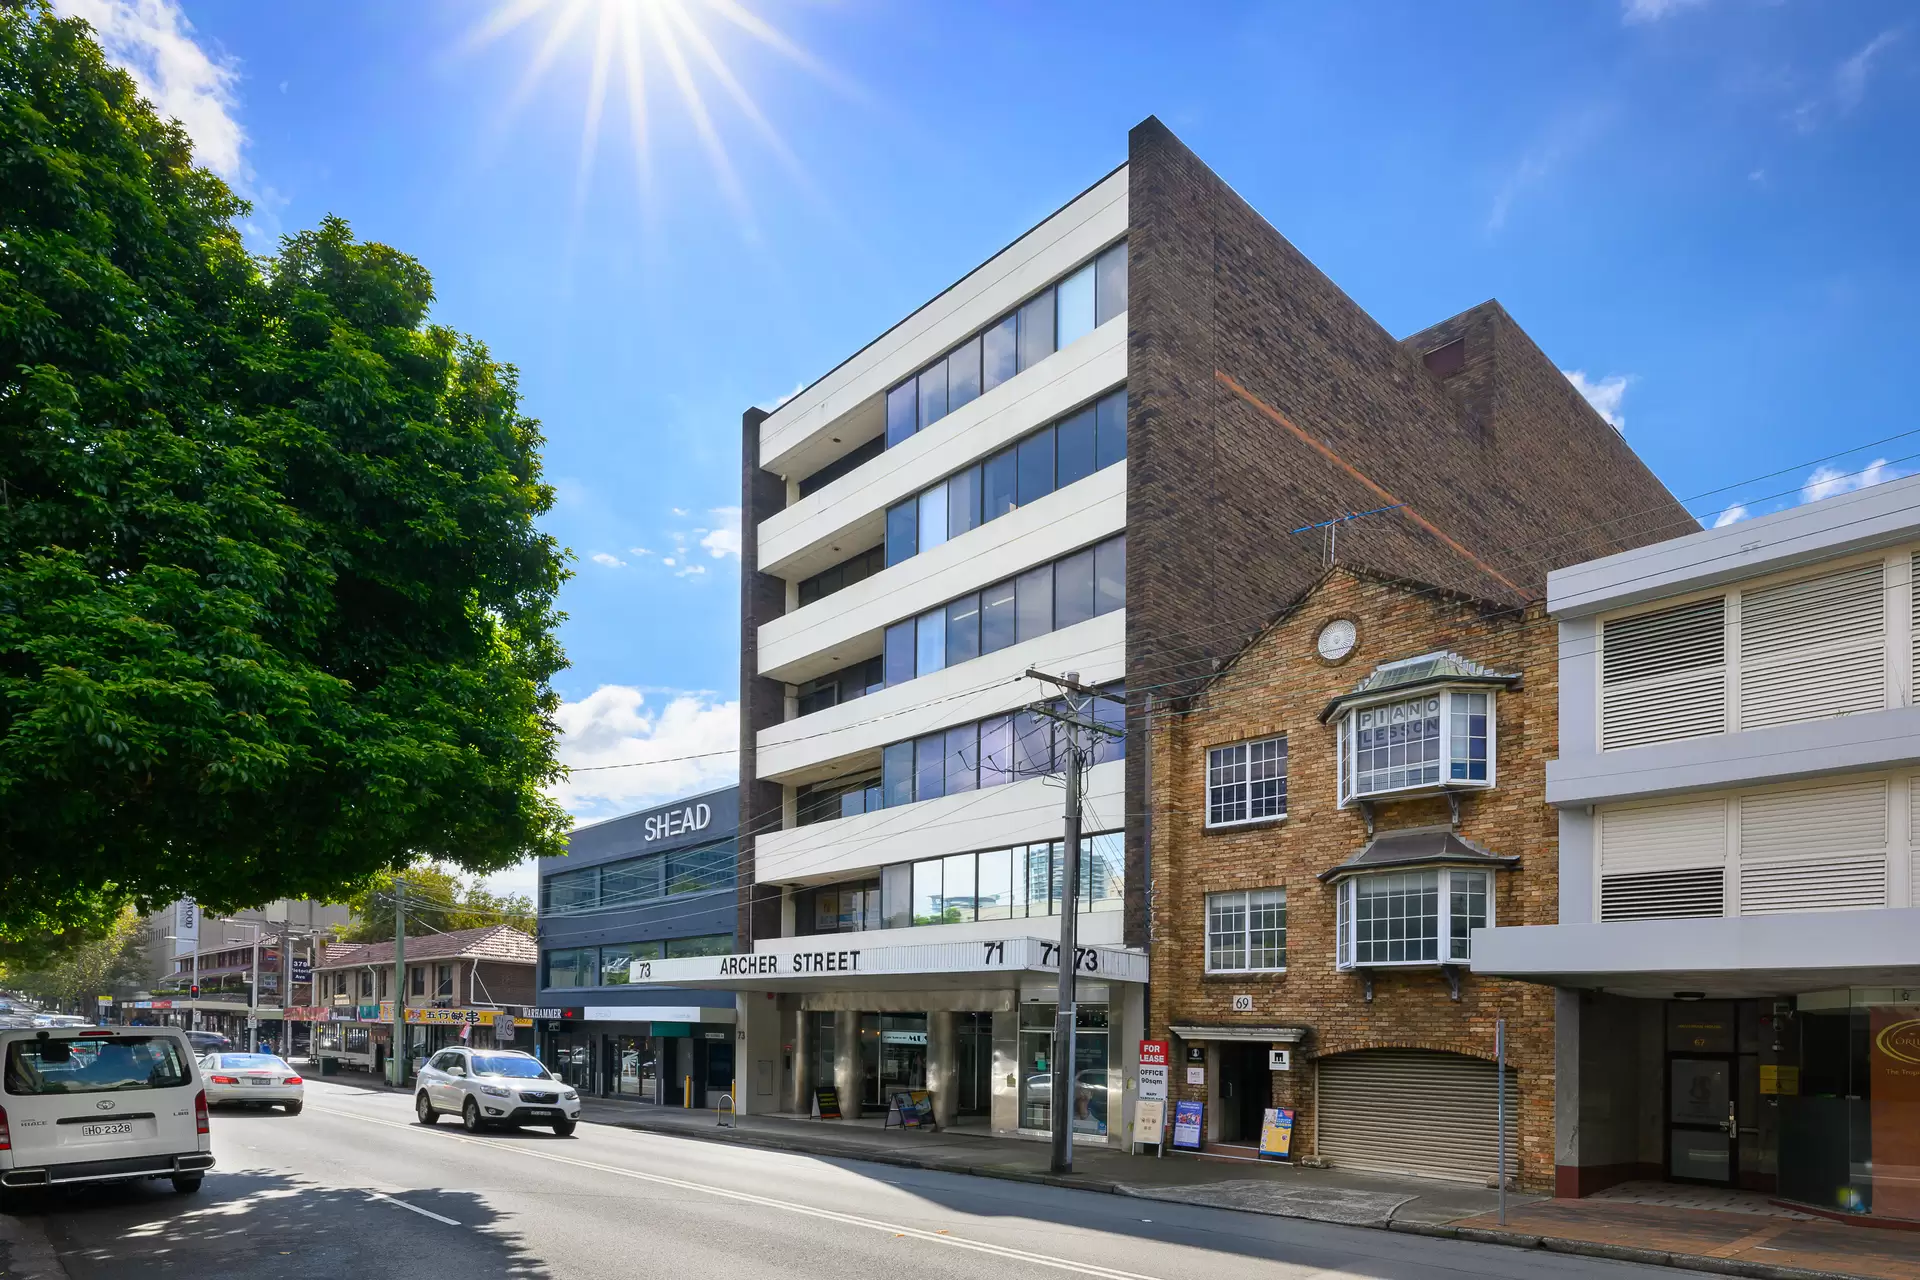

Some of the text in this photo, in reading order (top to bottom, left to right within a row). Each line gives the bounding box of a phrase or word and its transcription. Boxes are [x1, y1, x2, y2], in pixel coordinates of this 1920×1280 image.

[1361, 700, 1439, 726] PIANO
[1363, 718, 1437, 743] LESSON
[644, 803, 711, 841] SHEAD
[984, 942, 1004, 965] 71
[720, 950, 861, 975] ARCHER STREET
[639, 962, 651, 978] 73
[1236, 997, 1249, 1009] 69
[522, 1007, 562, 1019] WARHAMMER
[738, 1031, 746, 1040] 73
[1694, 1038, 1705, 1047] 67
[1143, 1045, 1160, 1053] FOR
[1139, 1054, 1164, 1063] LEASE
[1140, 1069, 1164, 1077] OFFICE
[1141, 1077, 1163, 1085] 90sqm
